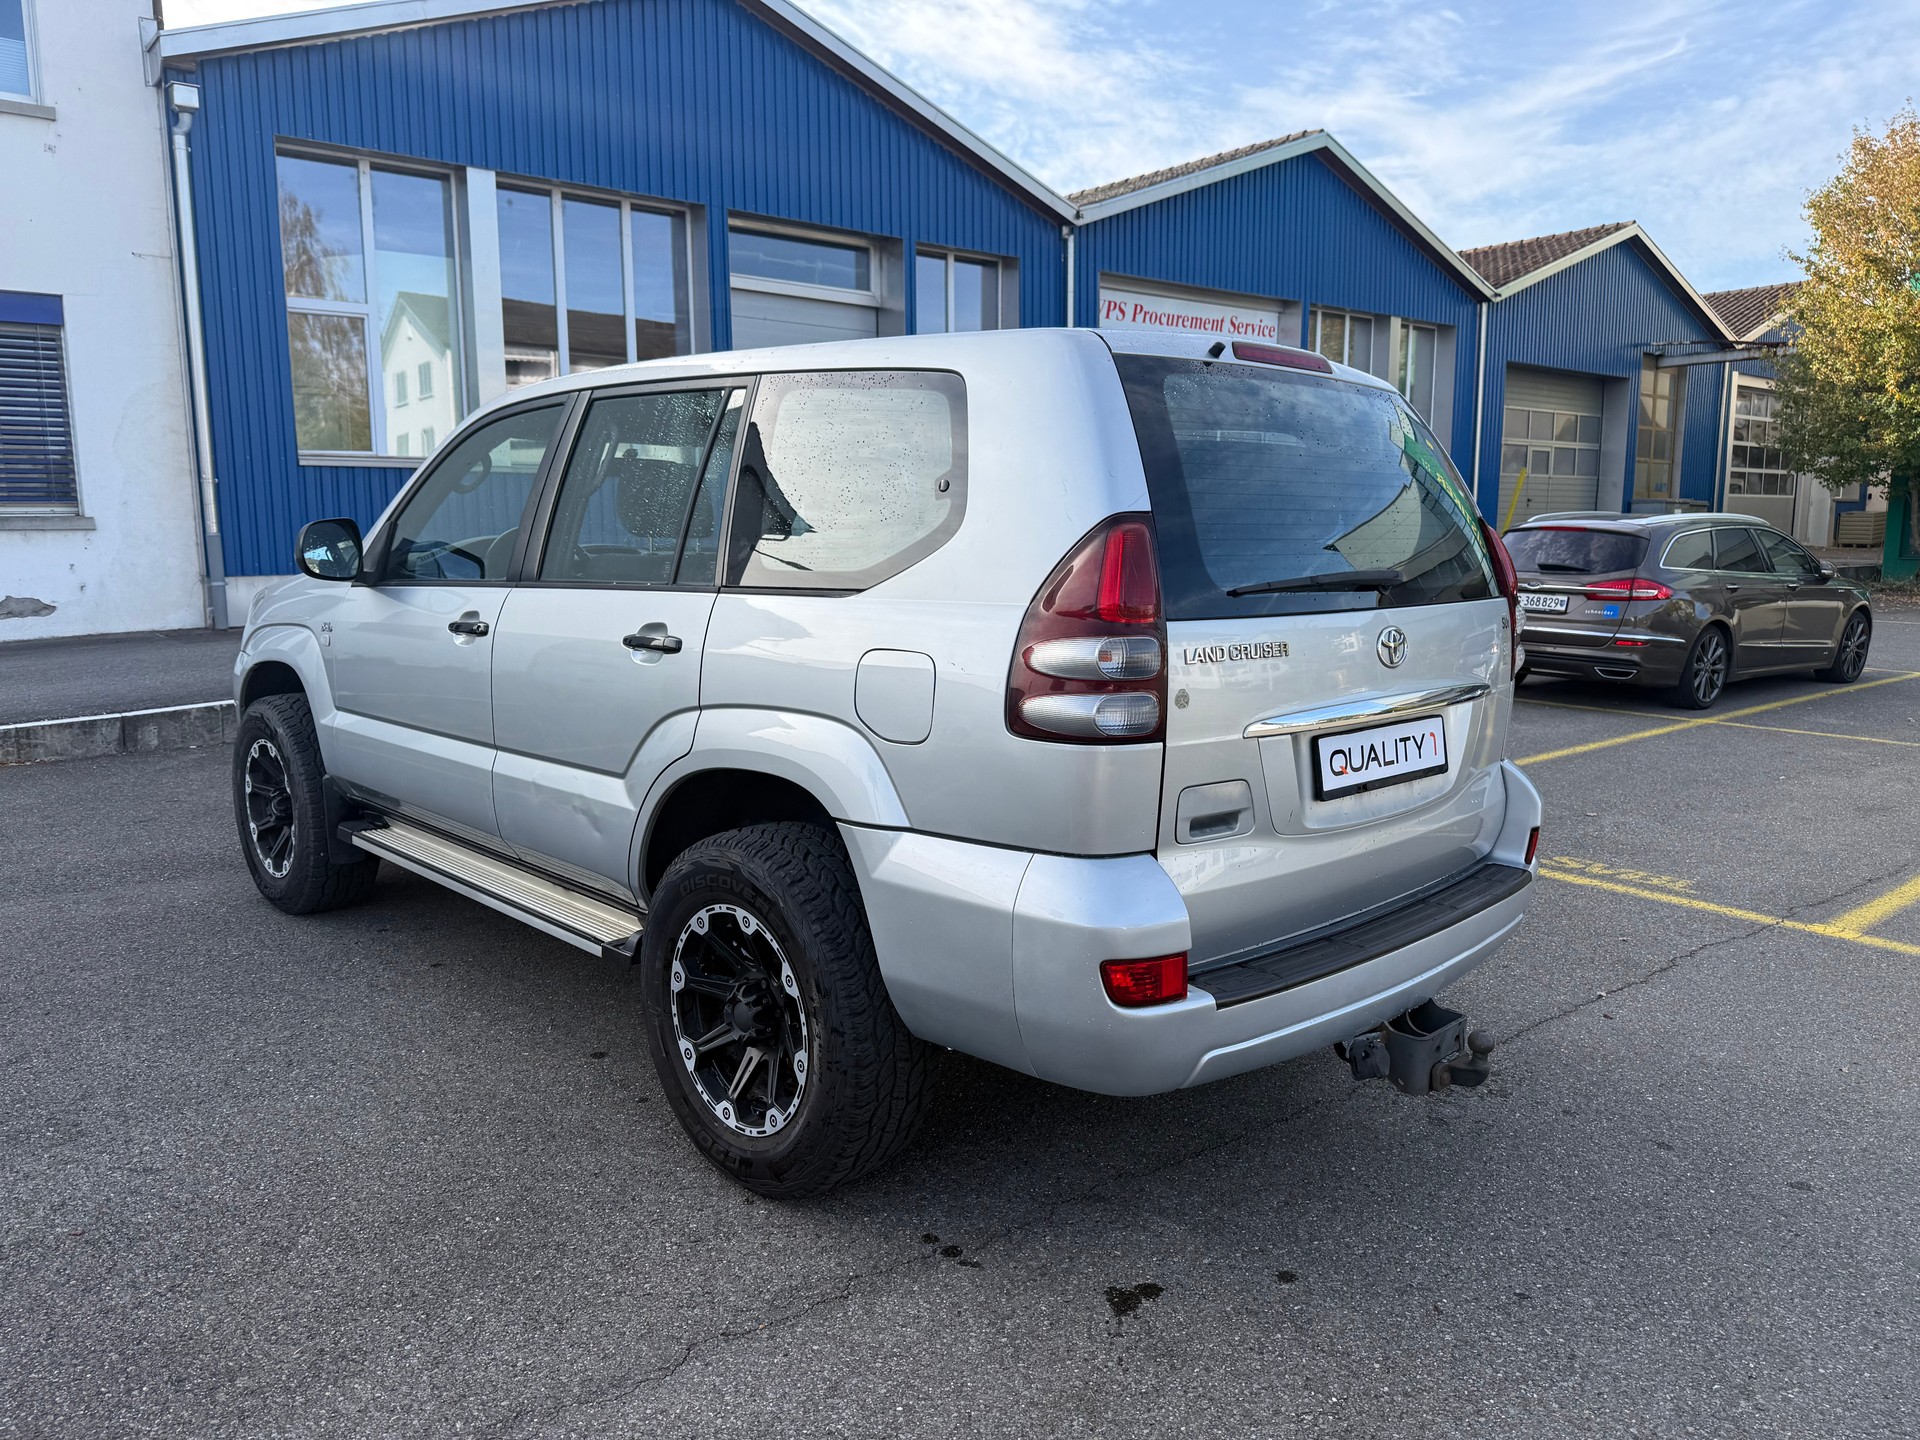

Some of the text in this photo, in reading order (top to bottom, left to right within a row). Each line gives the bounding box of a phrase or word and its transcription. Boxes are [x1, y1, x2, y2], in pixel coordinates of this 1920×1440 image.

[1131, 303, 1225, 333] Procurement
[1227, 315, 1276, 338] Service
[1584, 608, 1614, 616] schneider
[1184, 641, 1290, 665] LAND CRUISER
